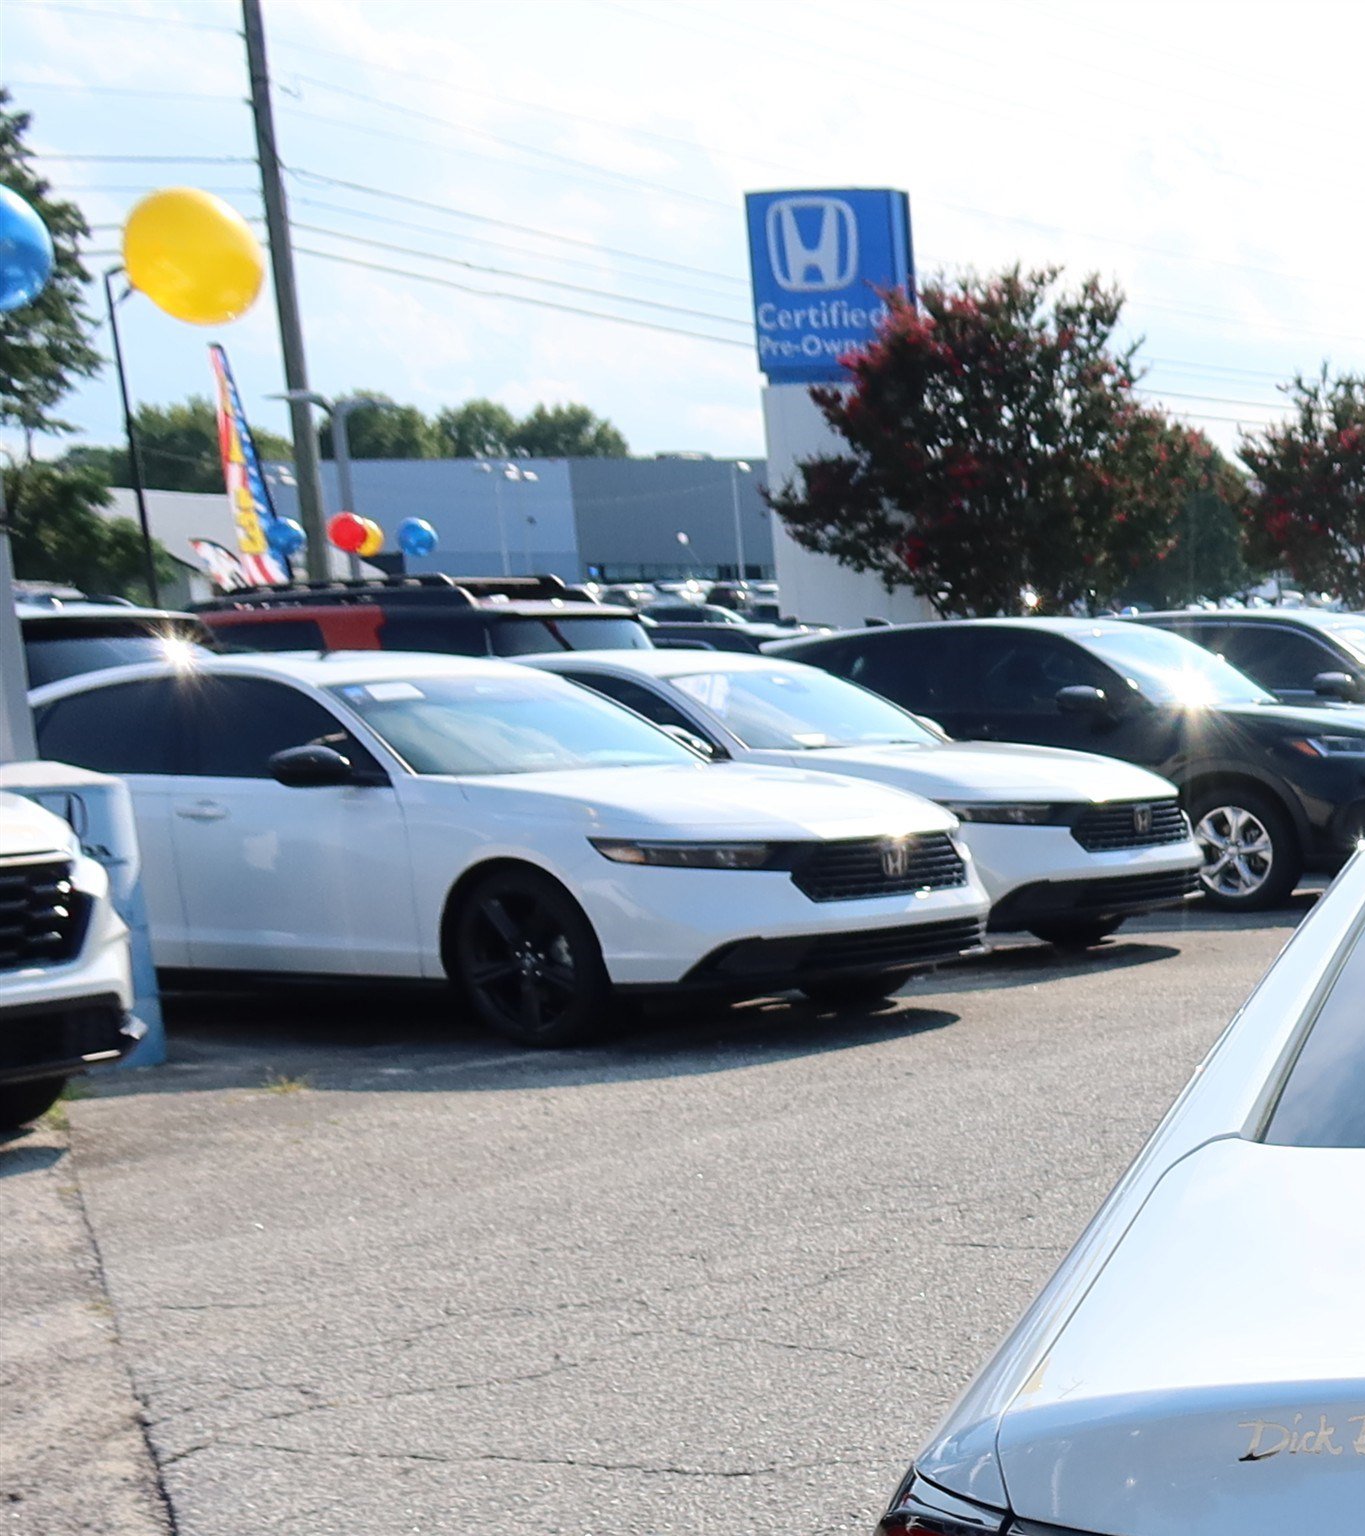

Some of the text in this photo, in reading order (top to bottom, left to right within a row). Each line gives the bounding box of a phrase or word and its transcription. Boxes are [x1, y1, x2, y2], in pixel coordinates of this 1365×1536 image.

[757, 301, 891, 331] Certified
[758, 333, 882, 359] Pre-Own
[1237, 1412, 1342, 1462] Dick
